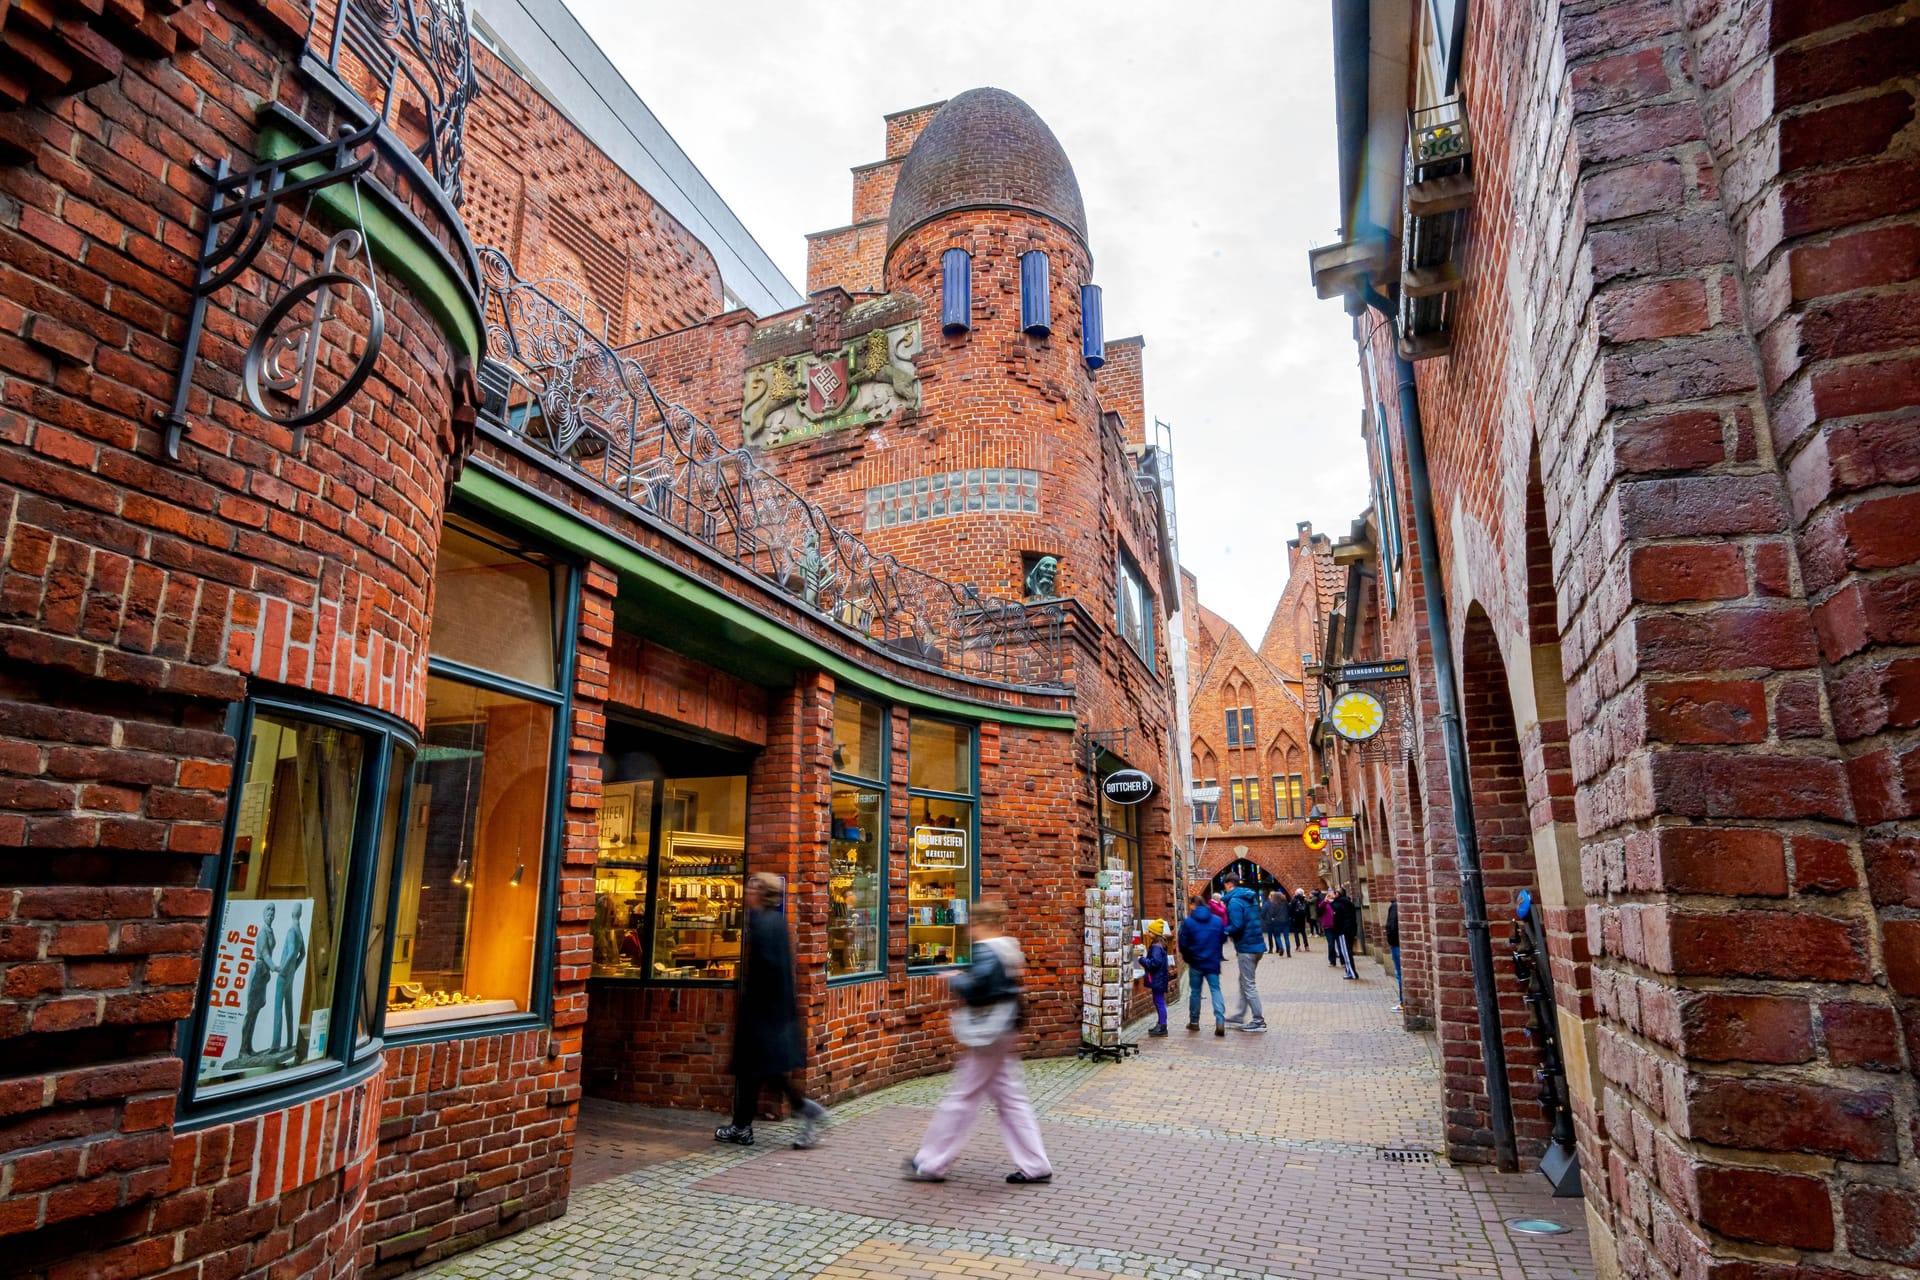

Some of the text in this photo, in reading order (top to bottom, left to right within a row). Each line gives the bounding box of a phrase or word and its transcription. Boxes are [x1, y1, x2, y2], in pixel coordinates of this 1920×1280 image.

[1106, 780, 1148, 793] BØTTCHER 8
[918, 833, 963, 848] BREMER SEIFEN
